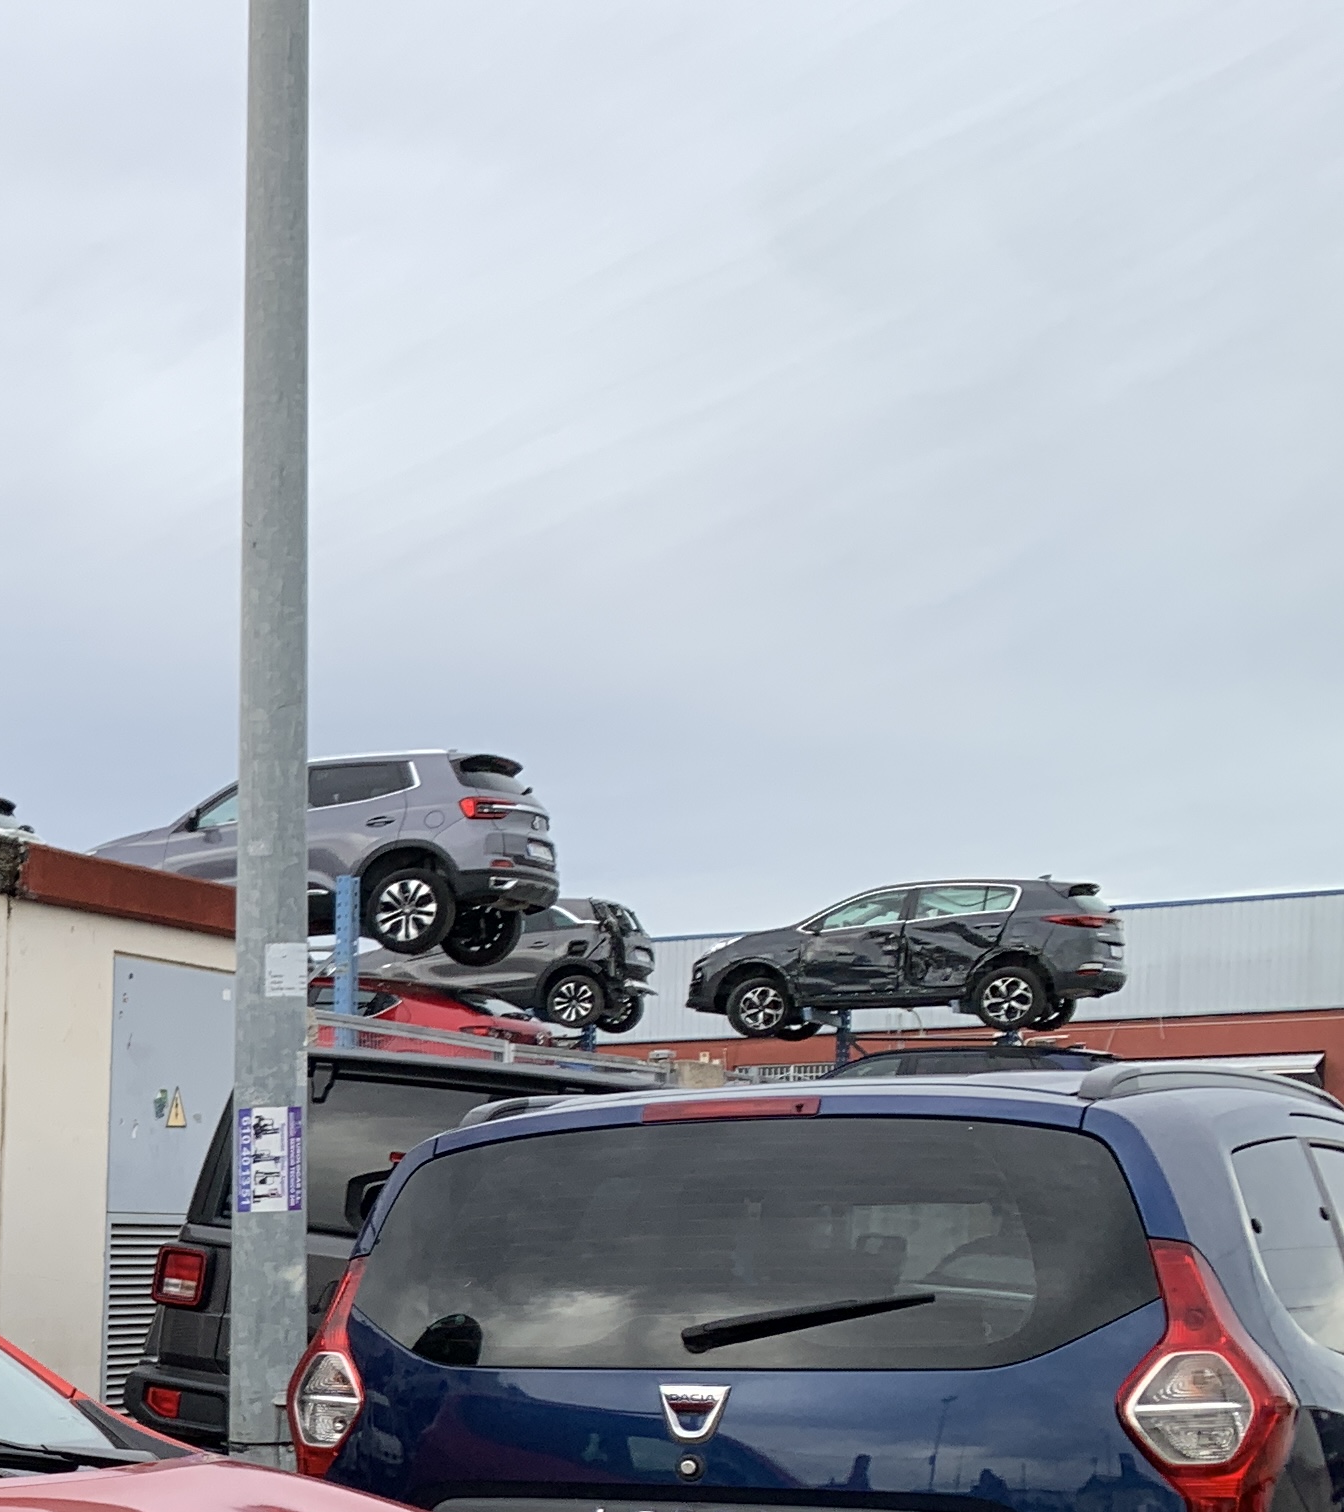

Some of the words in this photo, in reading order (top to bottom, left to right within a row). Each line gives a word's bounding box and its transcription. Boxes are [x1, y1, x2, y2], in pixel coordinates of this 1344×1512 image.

[241, 1116, 251, 1144] 610
[241, 1147, 251, 1165] 40
[670, 1393, 715, 1402] DACIA
